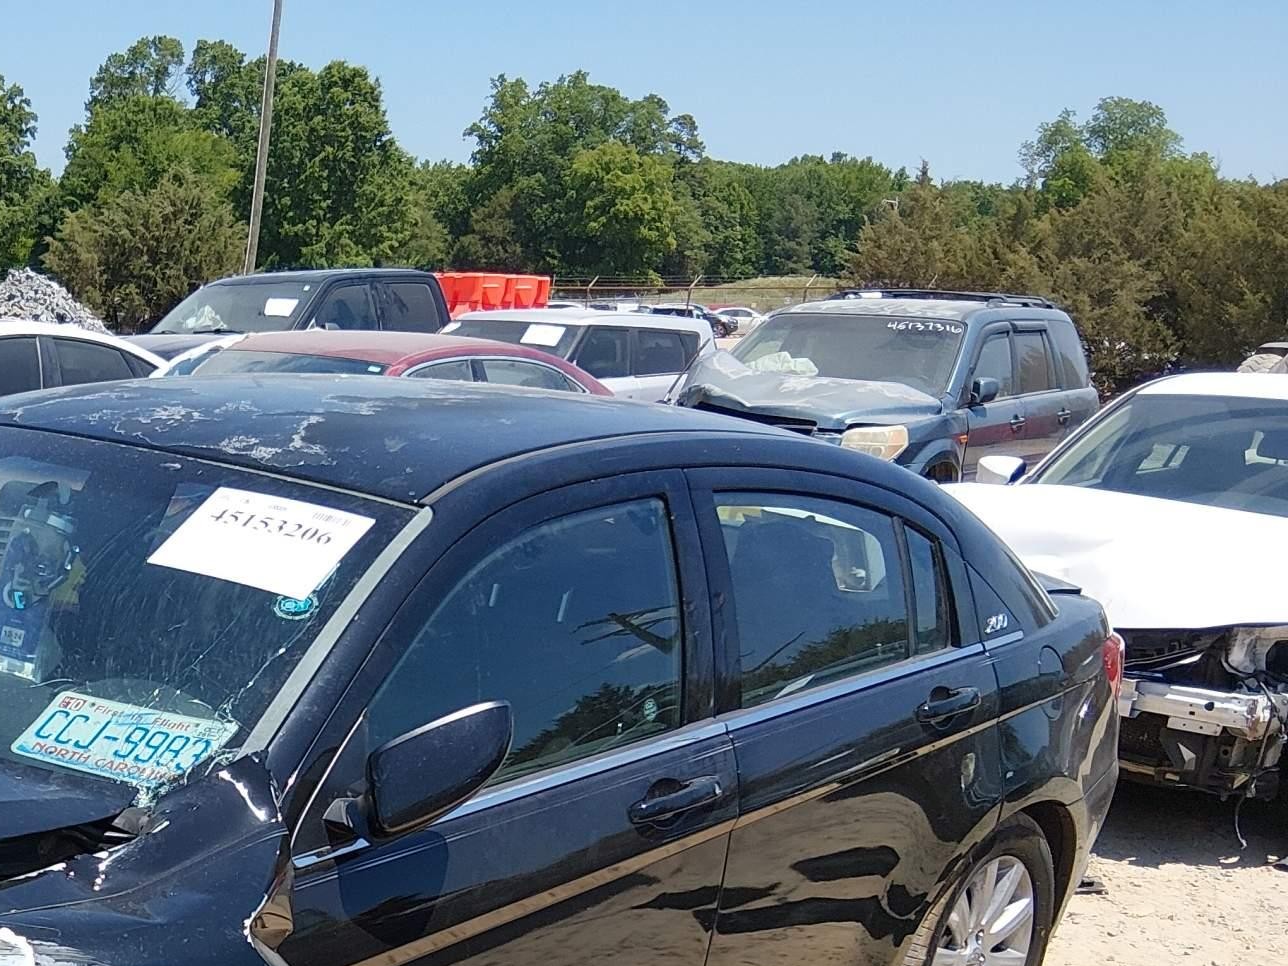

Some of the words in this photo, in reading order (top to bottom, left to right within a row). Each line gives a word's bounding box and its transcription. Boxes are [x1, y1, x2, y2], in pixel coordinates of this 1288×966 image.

[210, 508, 333, 545] 45153206
[984, 613, 1008, 634] 200
[94, 704, 124, 718] First
[152, 717, 191, 731] Flight
[31, 741, 91, 764] NORTH
